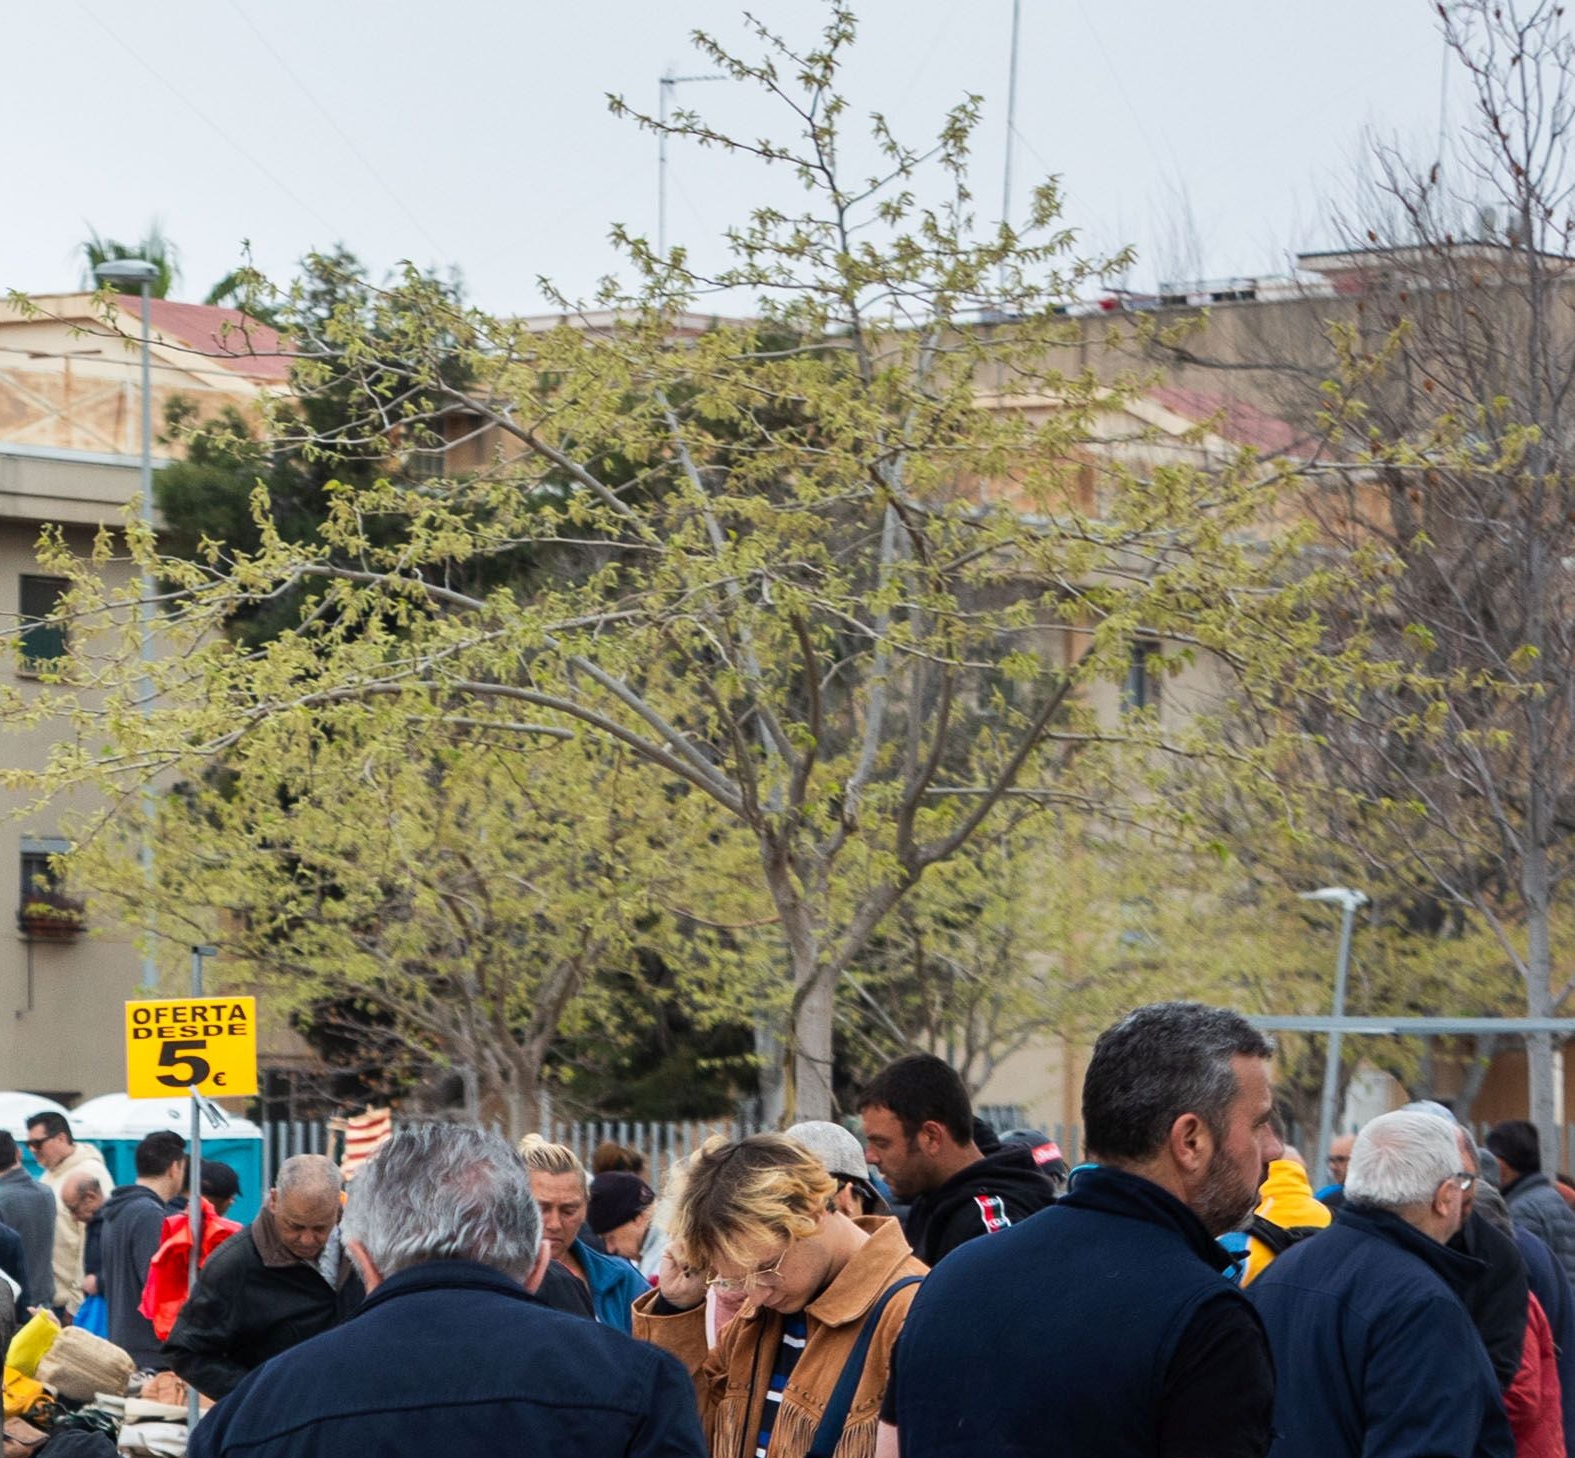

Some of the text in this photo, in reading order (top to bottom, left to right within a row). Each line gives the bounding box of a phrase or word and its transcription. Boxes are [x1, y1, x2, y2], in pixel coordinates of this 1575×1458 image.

[133, 1004, 247, 1025] OFERTA
[133, 1024, 247, 1039] DESDE
[156, 1040, 226, 1087] 5 €
